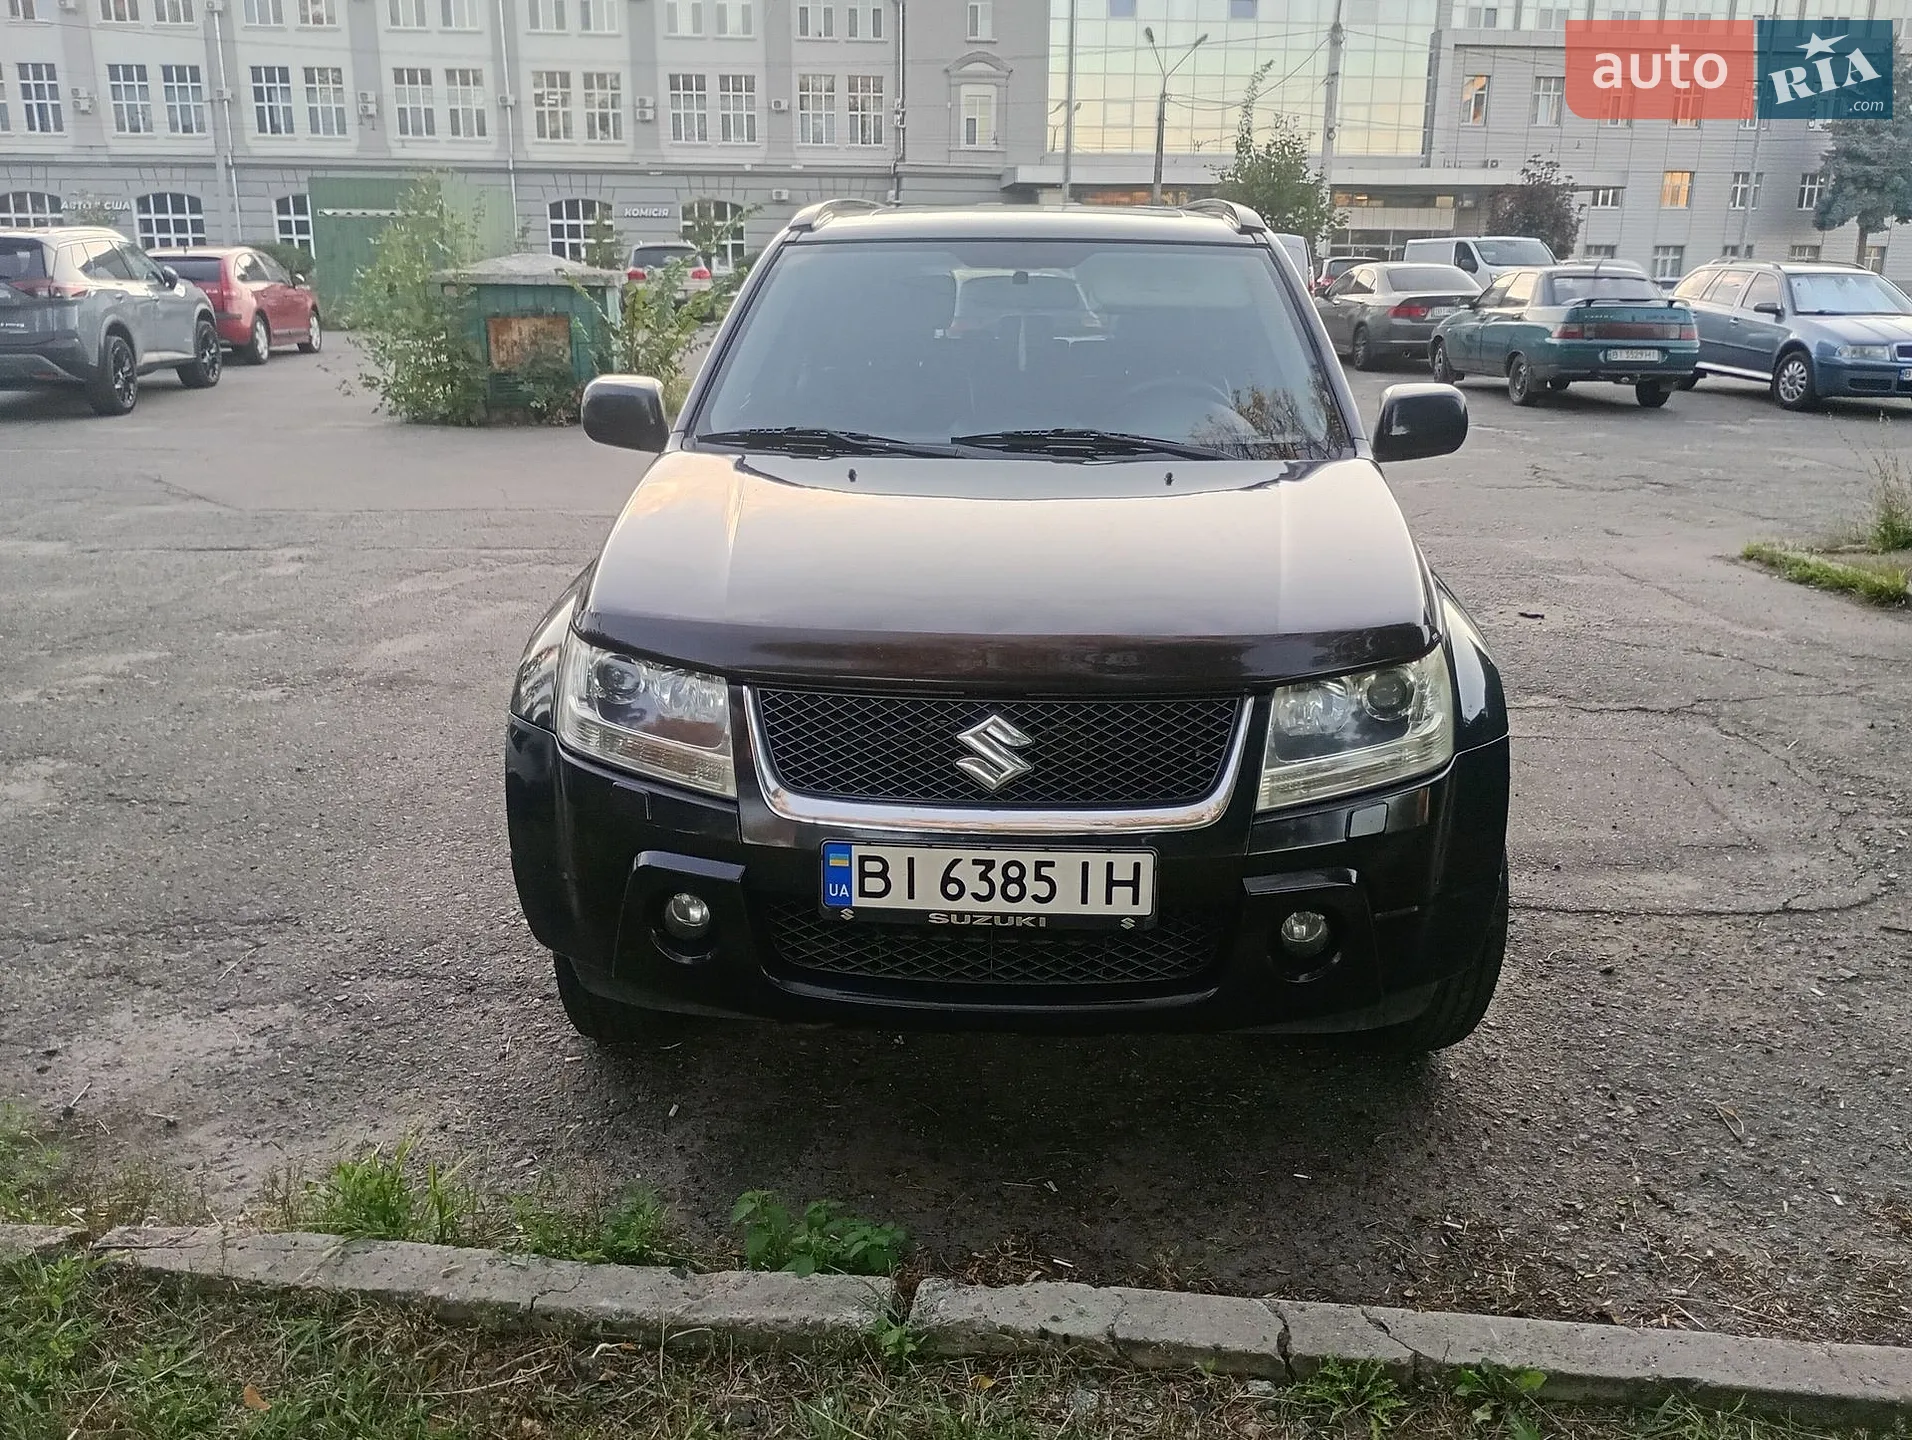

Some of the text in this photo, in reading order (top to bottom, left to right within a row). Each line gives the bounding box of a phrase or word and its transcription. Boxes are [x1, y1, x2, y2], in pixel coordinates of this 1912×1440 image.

[103, 200, 131, 210] США
[624, 207, 669, 217] КОМІСІЯ
[858, 854, 1141, 906] BI 6385 IH
[829, 883, 849, 898] UA
[928, 912, 1047, 928] SUZUKI
